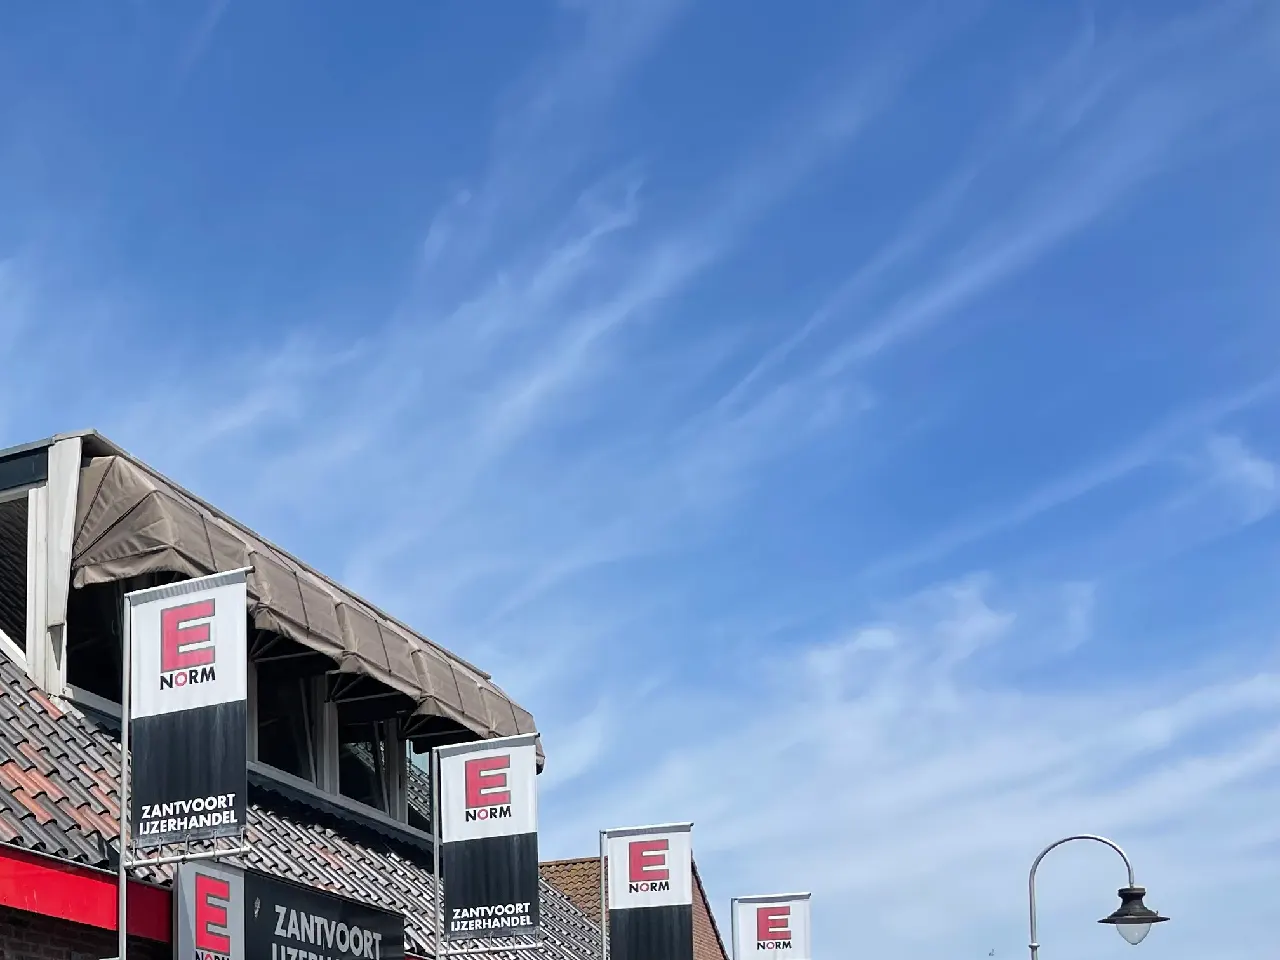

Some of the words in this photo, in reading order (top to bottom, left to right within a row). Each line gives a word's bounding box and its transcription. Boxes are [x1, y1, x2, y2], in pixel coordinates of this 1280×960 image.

[160, 598, 216, 673] E
[159, 666, 217, 690] NORM
[464, 754, 512, 810] E
[141, 793, 236, 819] ZANTVOORT
[465, 805, 512, 822] NORM
[138, 810, 238, 836] IJZERHANDEL
[628, 838, 670, 883] E
[628, 880, 670, 894] NORM
[194, 872, 231, 956] E
[450, 915, 534, 932] IJZERHANDEL
[452, 902, 531, 919] ZANTVOORT
[756, 905, 792, 942] E
[756, 939, 793, 951] NORM
